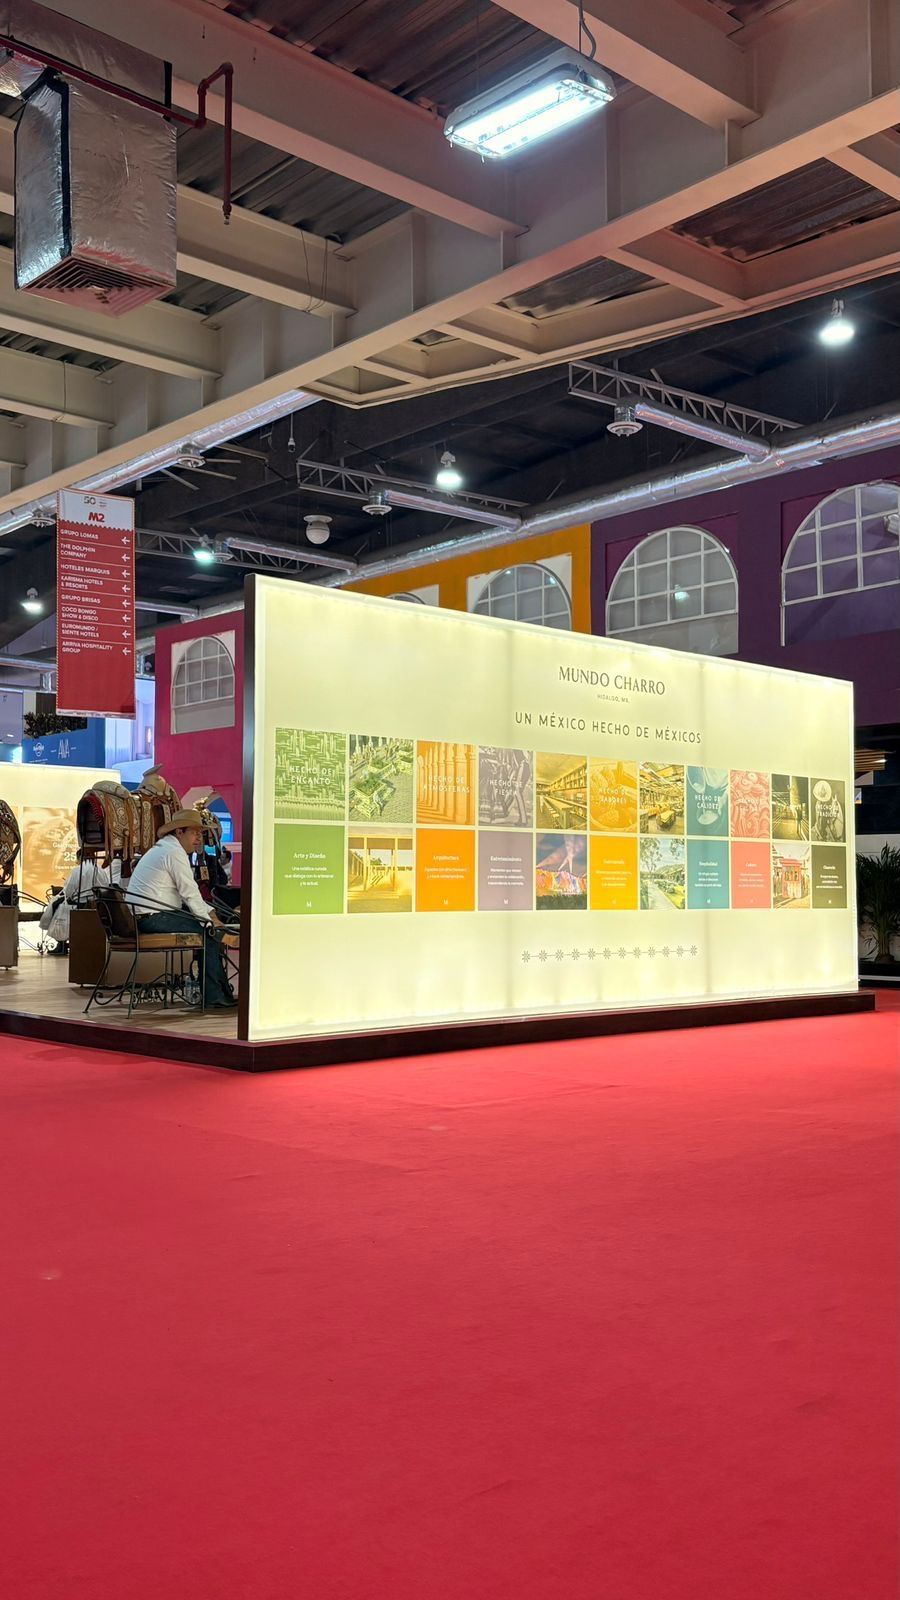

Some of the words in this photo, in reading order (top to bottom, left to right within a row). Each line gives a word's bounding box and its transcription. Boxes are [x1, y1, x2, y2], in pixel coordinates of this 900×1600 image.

[88, 512, 105, 523] M2
[60, 529, 79, 537] GRUPO
[60, 550, 87, 558] COMPANY
[85, 566, 110, 575] MARQUIS
[62, 623, 96, 631] EUROMUNDO
[558, 666, 610, 688] MUNDO
[614, 674, 666, 696] CHARRO
[515, 712, 532, 725] UN
[538, 712, 586, 731] MÉXICO
[592, 720, 630, 736] HECHO
[636, 726, 649, 738] DE
[655, 726, 701, 744] MÉXICOS
[290, 766, 318, 774] HECHO
[290, 776, 331, 785] ENCANTO
[490, 779, 511, 787] HECHO
